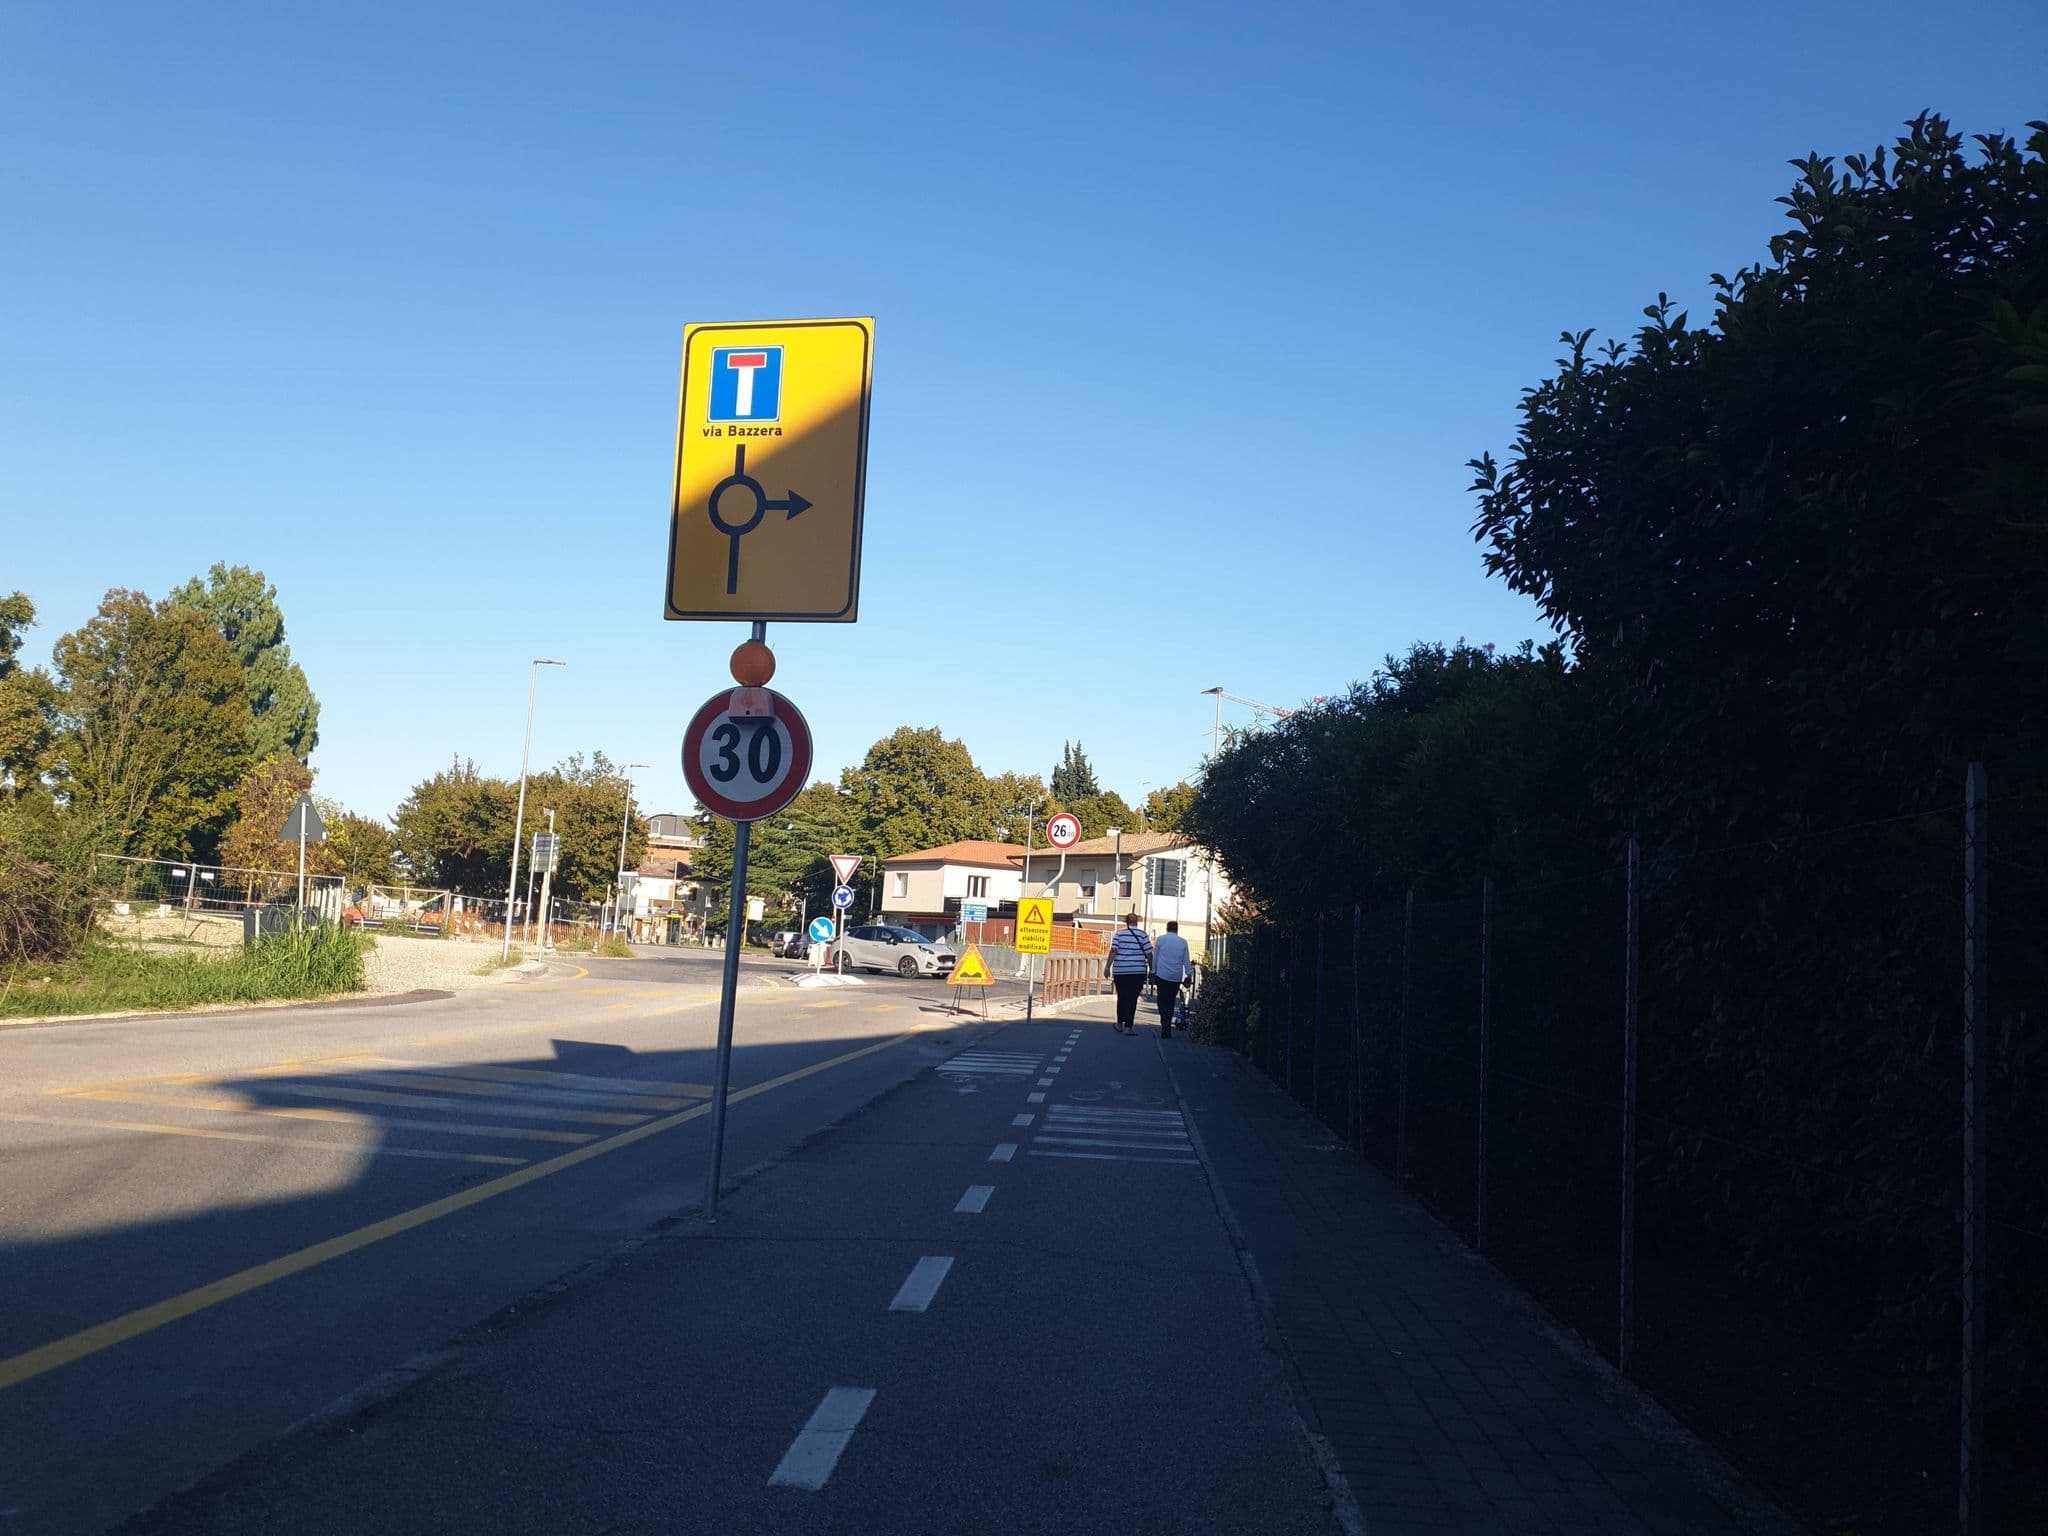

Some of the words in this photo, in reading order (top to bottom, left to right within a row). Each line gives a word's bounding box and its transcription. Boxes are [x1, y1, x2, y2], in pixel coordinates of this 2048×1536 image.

[703, 425, 722, 437] via
[728, 425, 782, 437] Bazzera
[709, 723, 782, 784] 30
